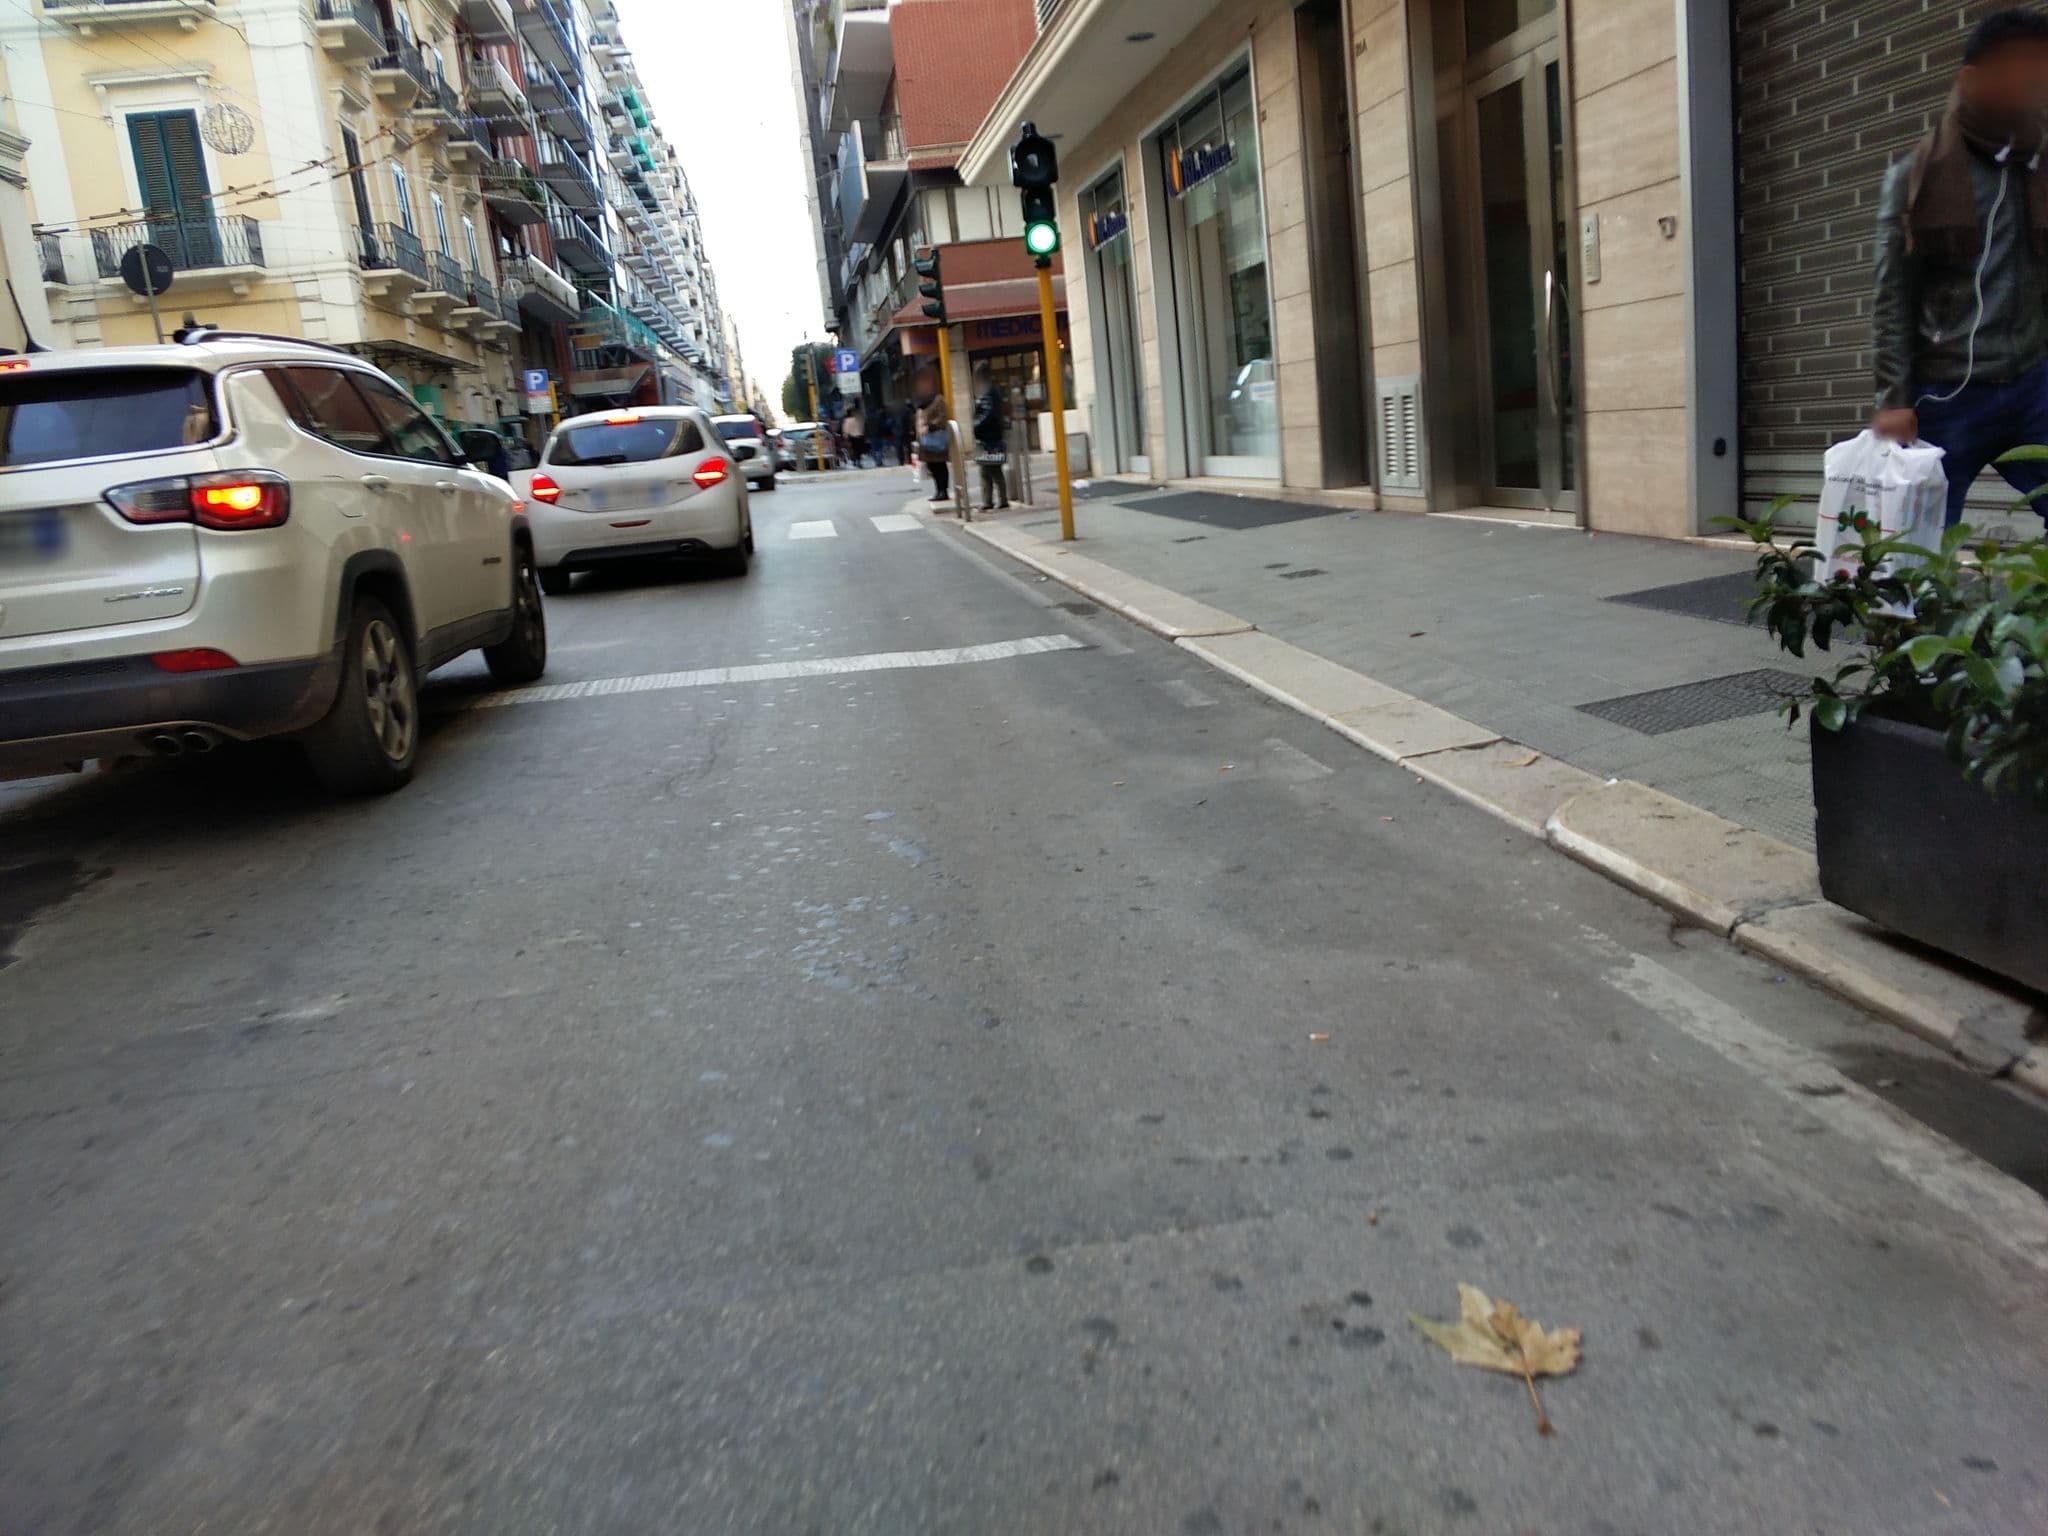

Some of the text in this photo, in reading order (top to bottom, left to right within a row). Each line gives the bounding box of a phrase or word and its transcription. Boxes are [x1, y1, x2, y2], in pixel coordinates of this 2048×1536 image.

[975, 317, 1042, 338] MEDIC
[841, 353, 855, 371] P
[529, 372, 544, 390] P
